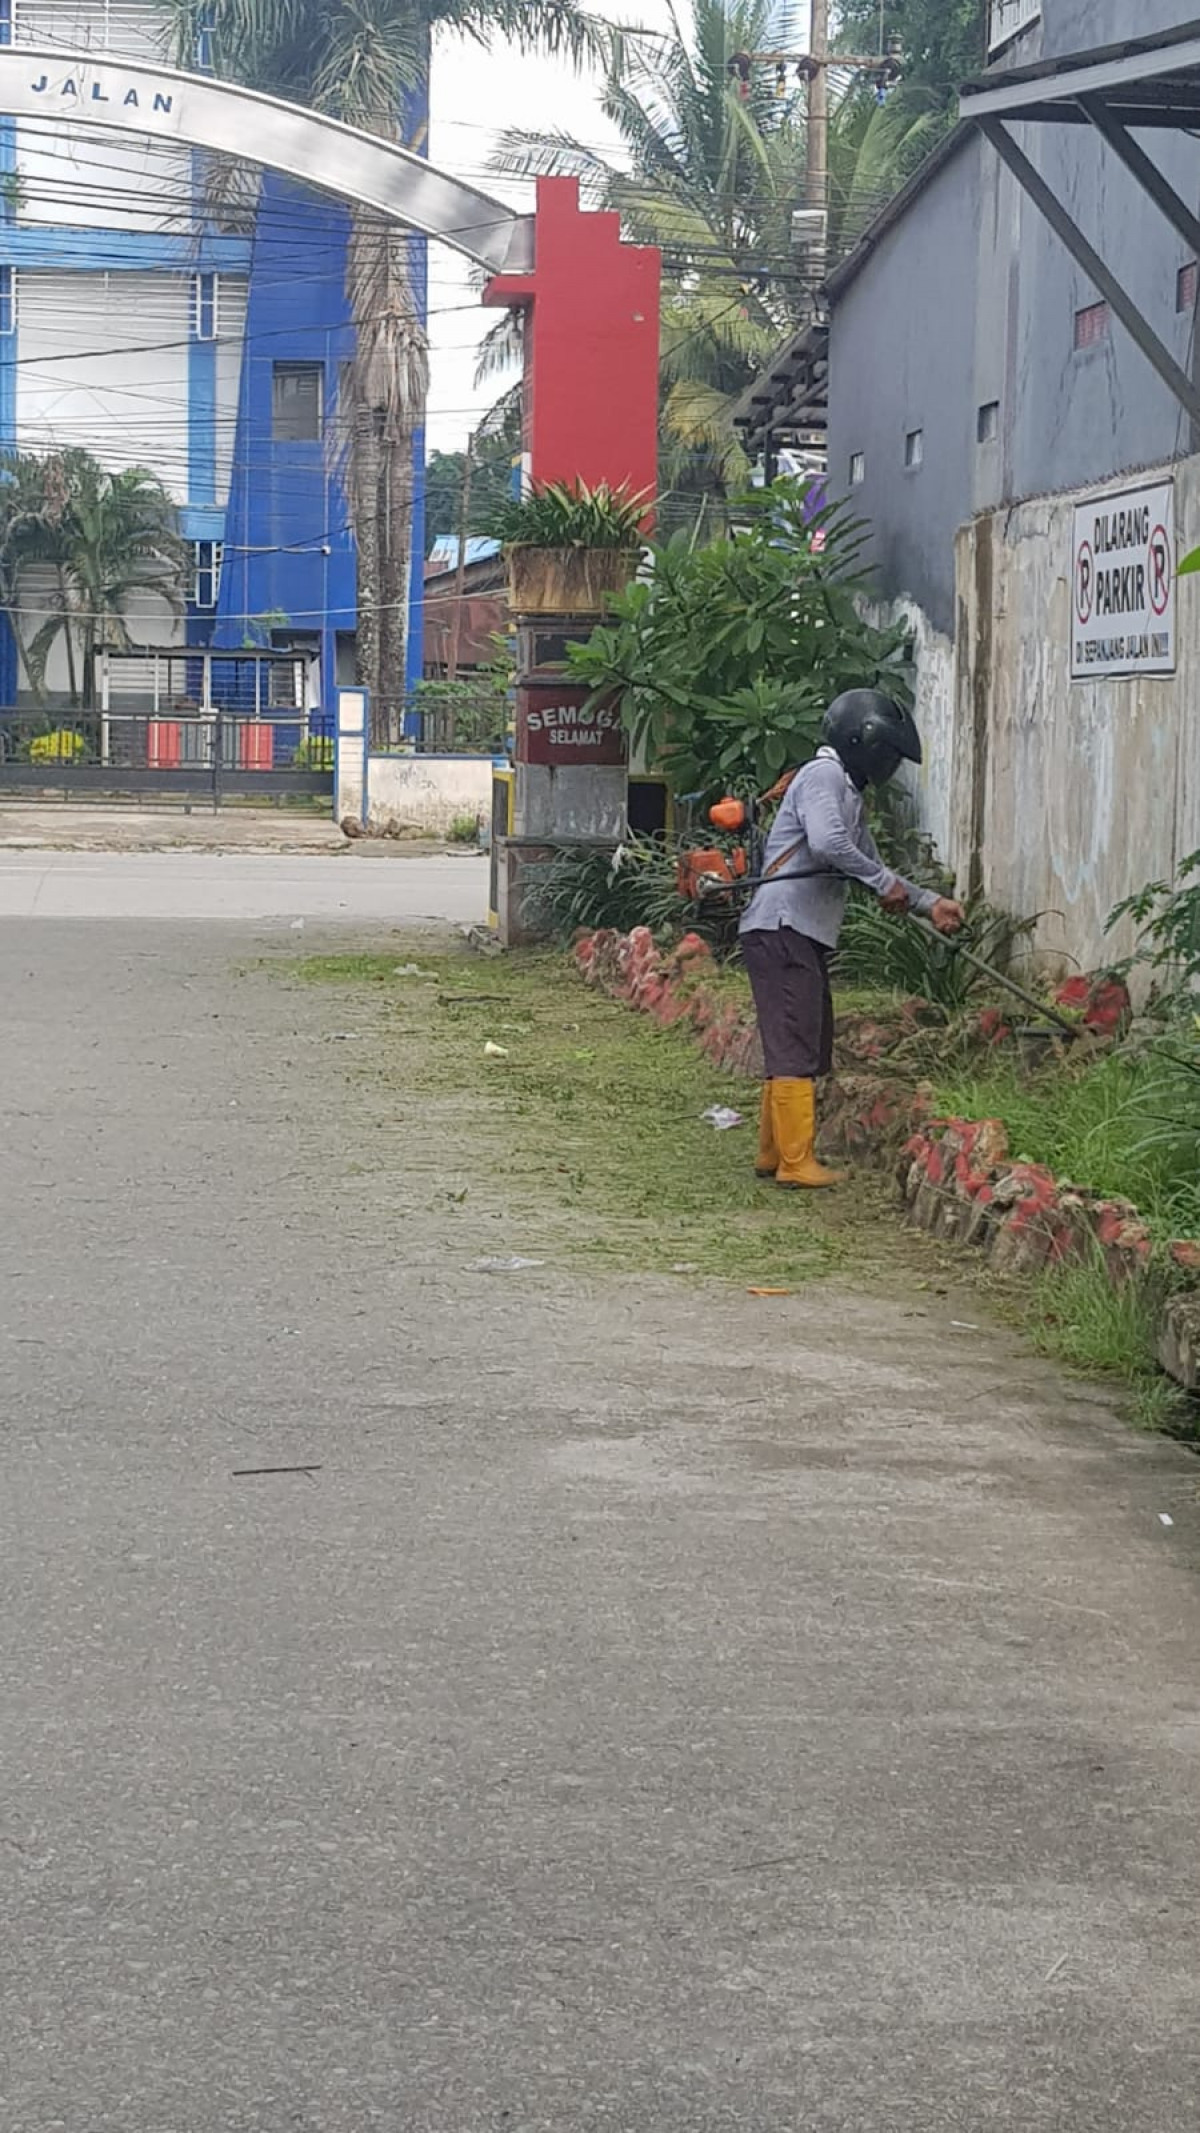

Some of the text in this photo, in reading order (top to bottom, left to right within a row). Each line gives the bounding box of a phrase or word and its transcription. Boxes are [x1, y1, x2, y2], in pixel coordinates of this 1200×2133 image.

[31, 75, 173, 113] JALAN
[1095, 505, 1149, 554] DILARANG
[1096, 564, 1145, 616] PARKIR
[549, 729, 604, 745] SELAMAT
